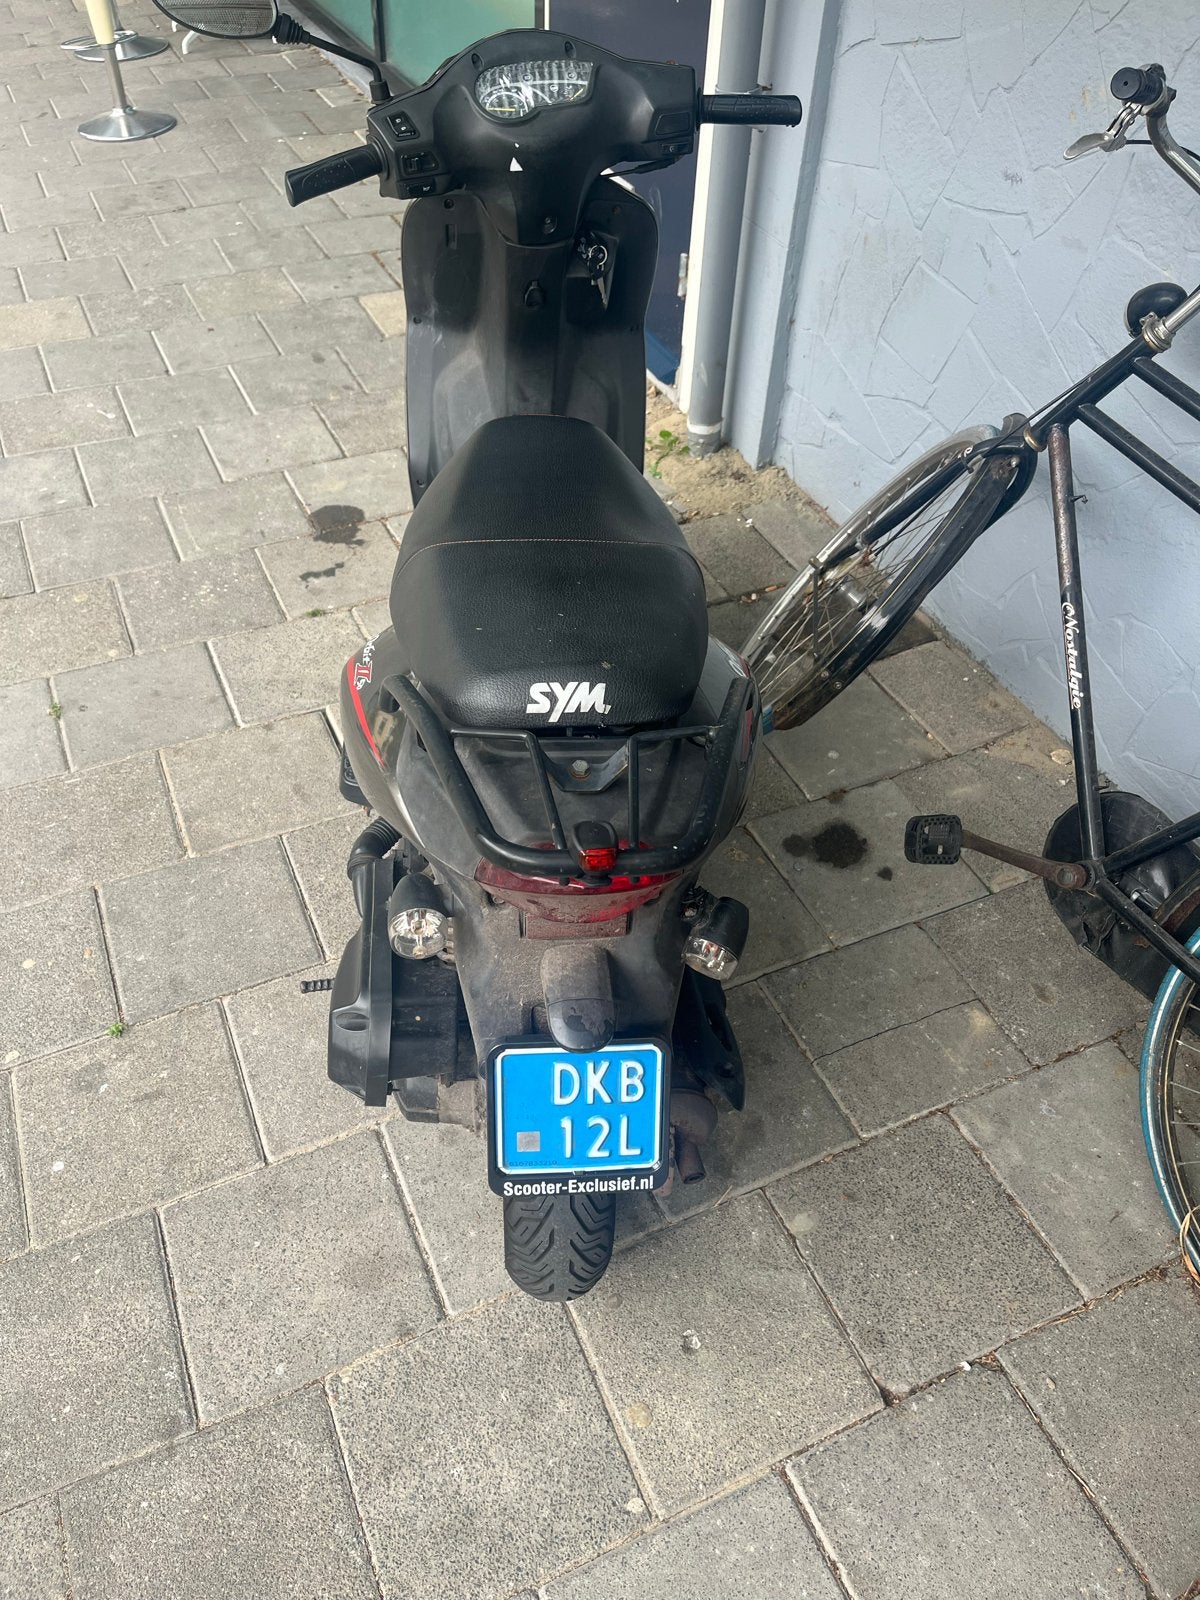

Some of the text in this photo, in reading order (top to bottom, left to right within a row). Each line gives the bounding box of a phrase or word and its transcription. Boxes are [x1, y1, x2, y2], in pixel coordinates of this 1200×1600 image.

[1061, 602, 1084, 710] Nostalgie
[525, 681, 611, 723] SYM
[552, 1059, 645, 1106] DKB
[559, 1114, 642, 1158] 12L
[503, 1175, 654, 1197] Scooter-Exclusief.nl
